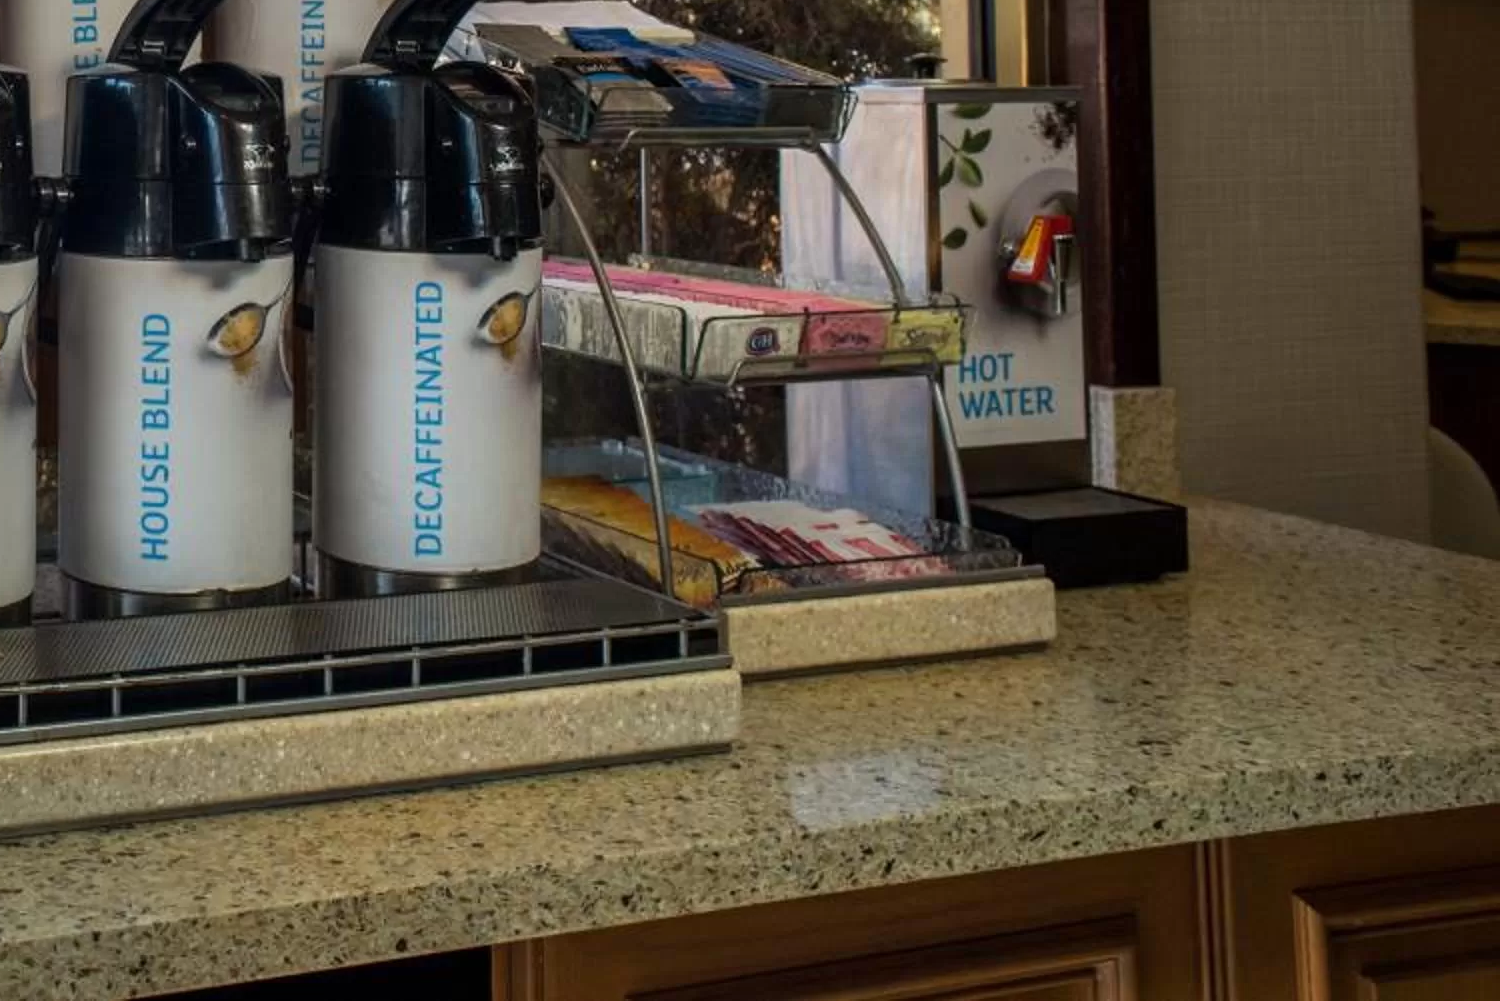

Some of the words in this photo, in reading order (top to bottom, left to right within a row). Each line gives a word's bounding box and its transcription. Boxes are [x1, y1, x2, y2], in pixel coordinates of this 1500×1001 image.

[141, 312, 172, 431] BLEND
[414, 280, 444, 558] DECAFFEINATED
[959, 353, 1013, 384] HOT
[960, 386, 1053, 418] WATER
[141, 441, 171, 563] HOUSE
